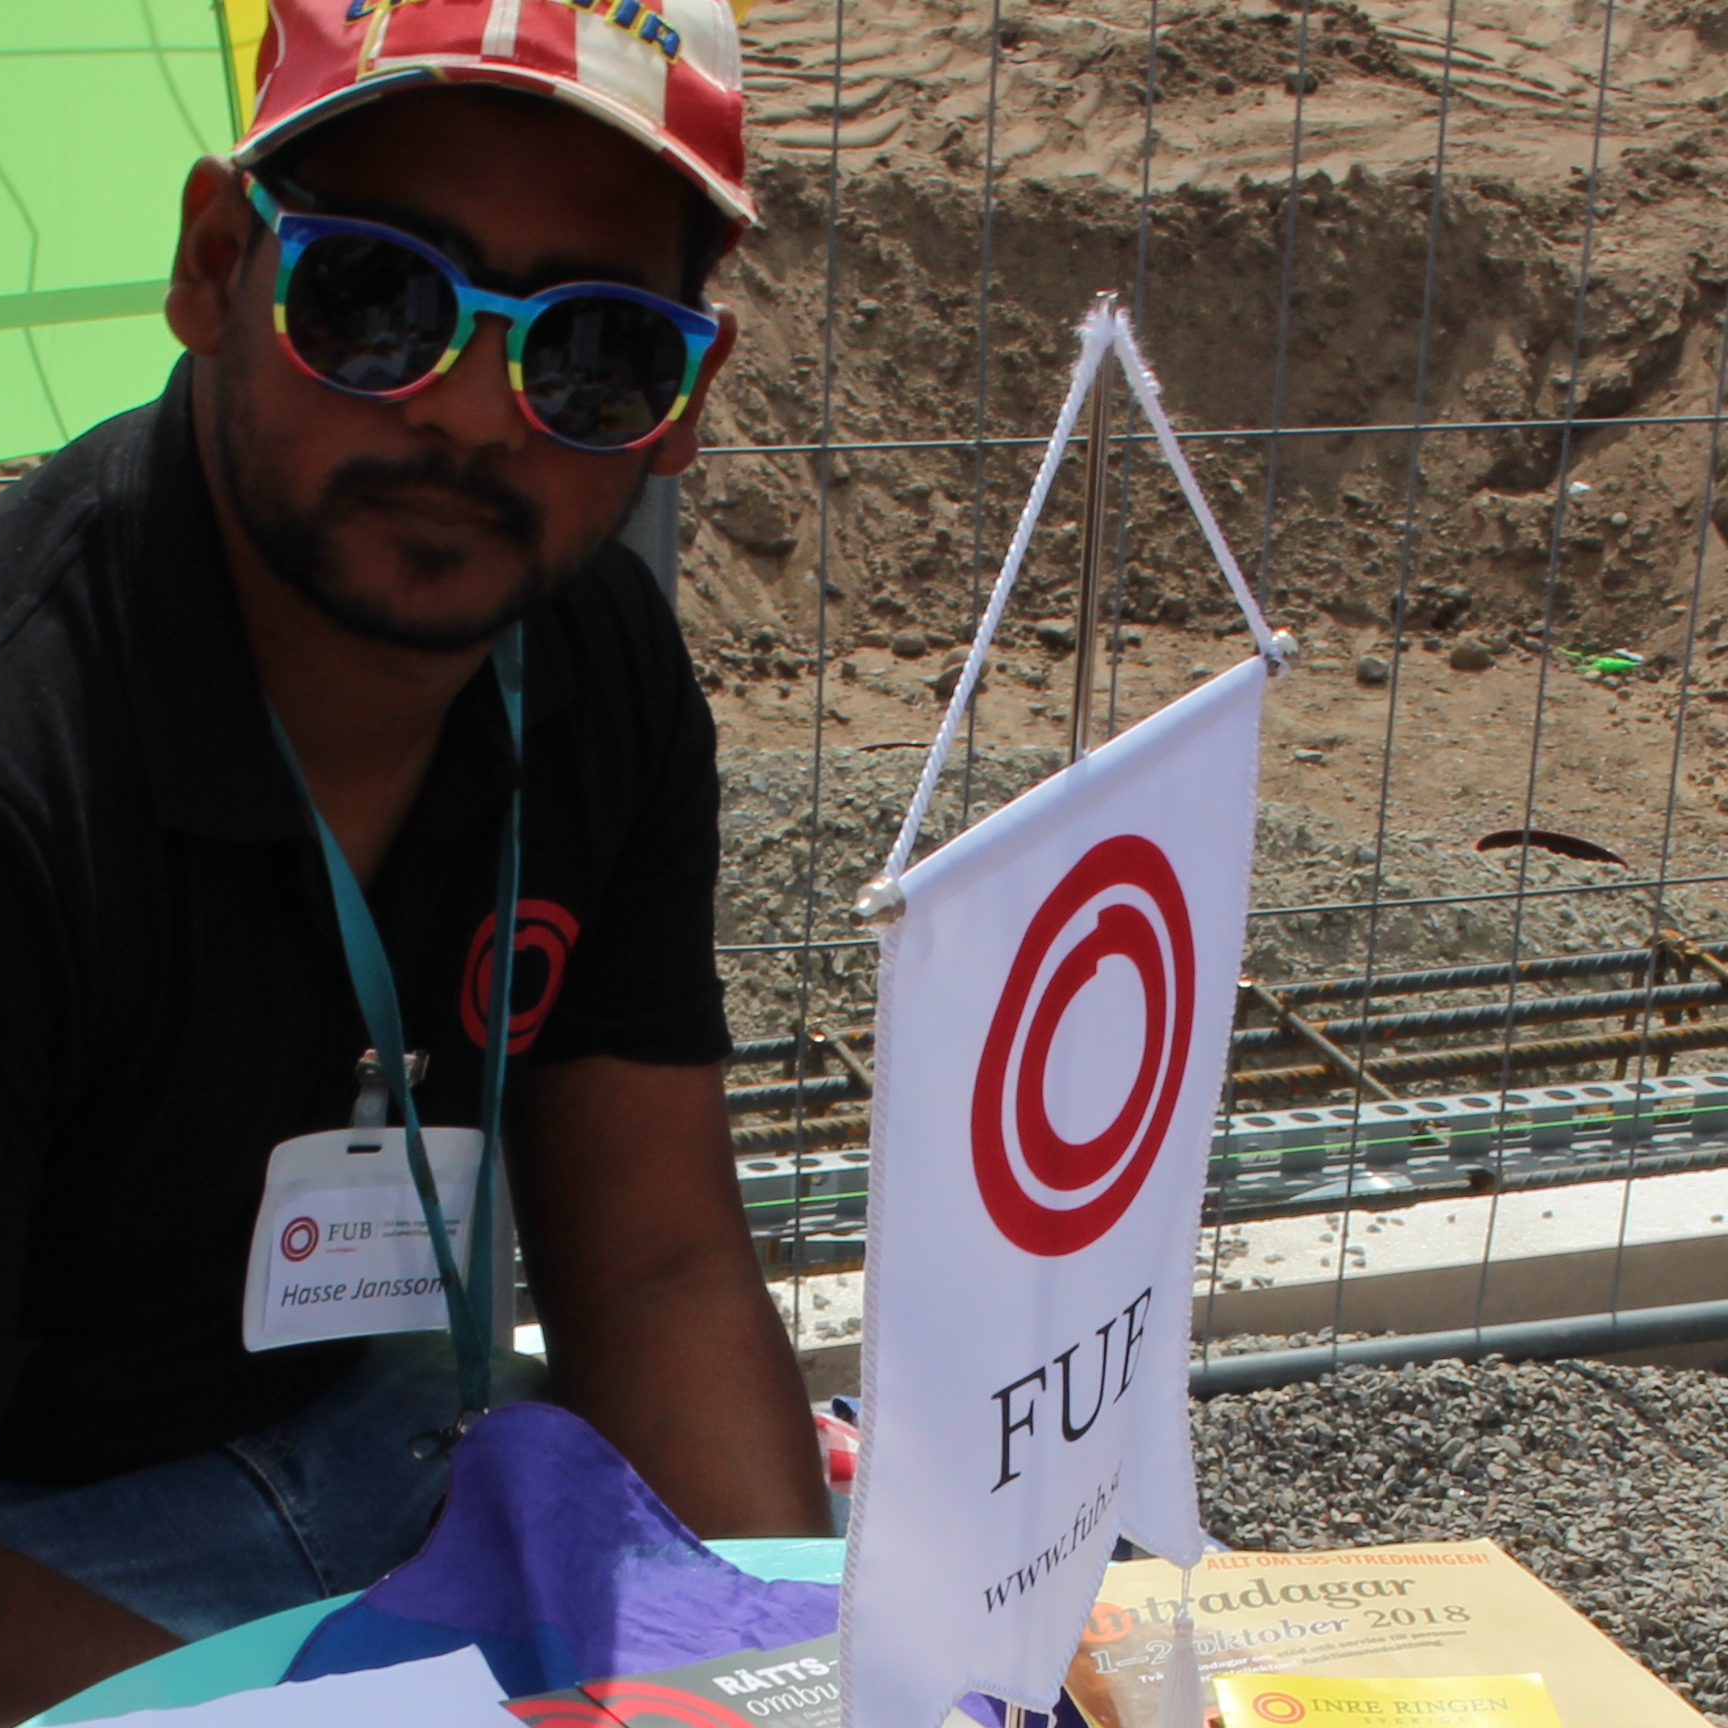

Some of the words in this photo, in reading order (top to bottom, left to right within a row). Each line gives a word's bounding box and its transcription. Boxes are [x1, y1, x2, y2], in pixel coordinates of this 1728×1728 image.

[327, 1222, 372, 1242] FUB
[281, 1281, 346, 1308] Hasse
[352, 1274, 445, 1300] Jansson
[1206, 1556, 1251, 1571] ALLT
[1263, 1555, 1291, 1568] OM
[1193, 1616, 1350, 1657] oktober
[1364, 1604, 1471, 1629] 2018
[712, 1657, 839, 1695] RÄTTS-
[1310, 1697, 1383, 1715] INRE
[1394, 1696, 1509, 1715] RINGEN
